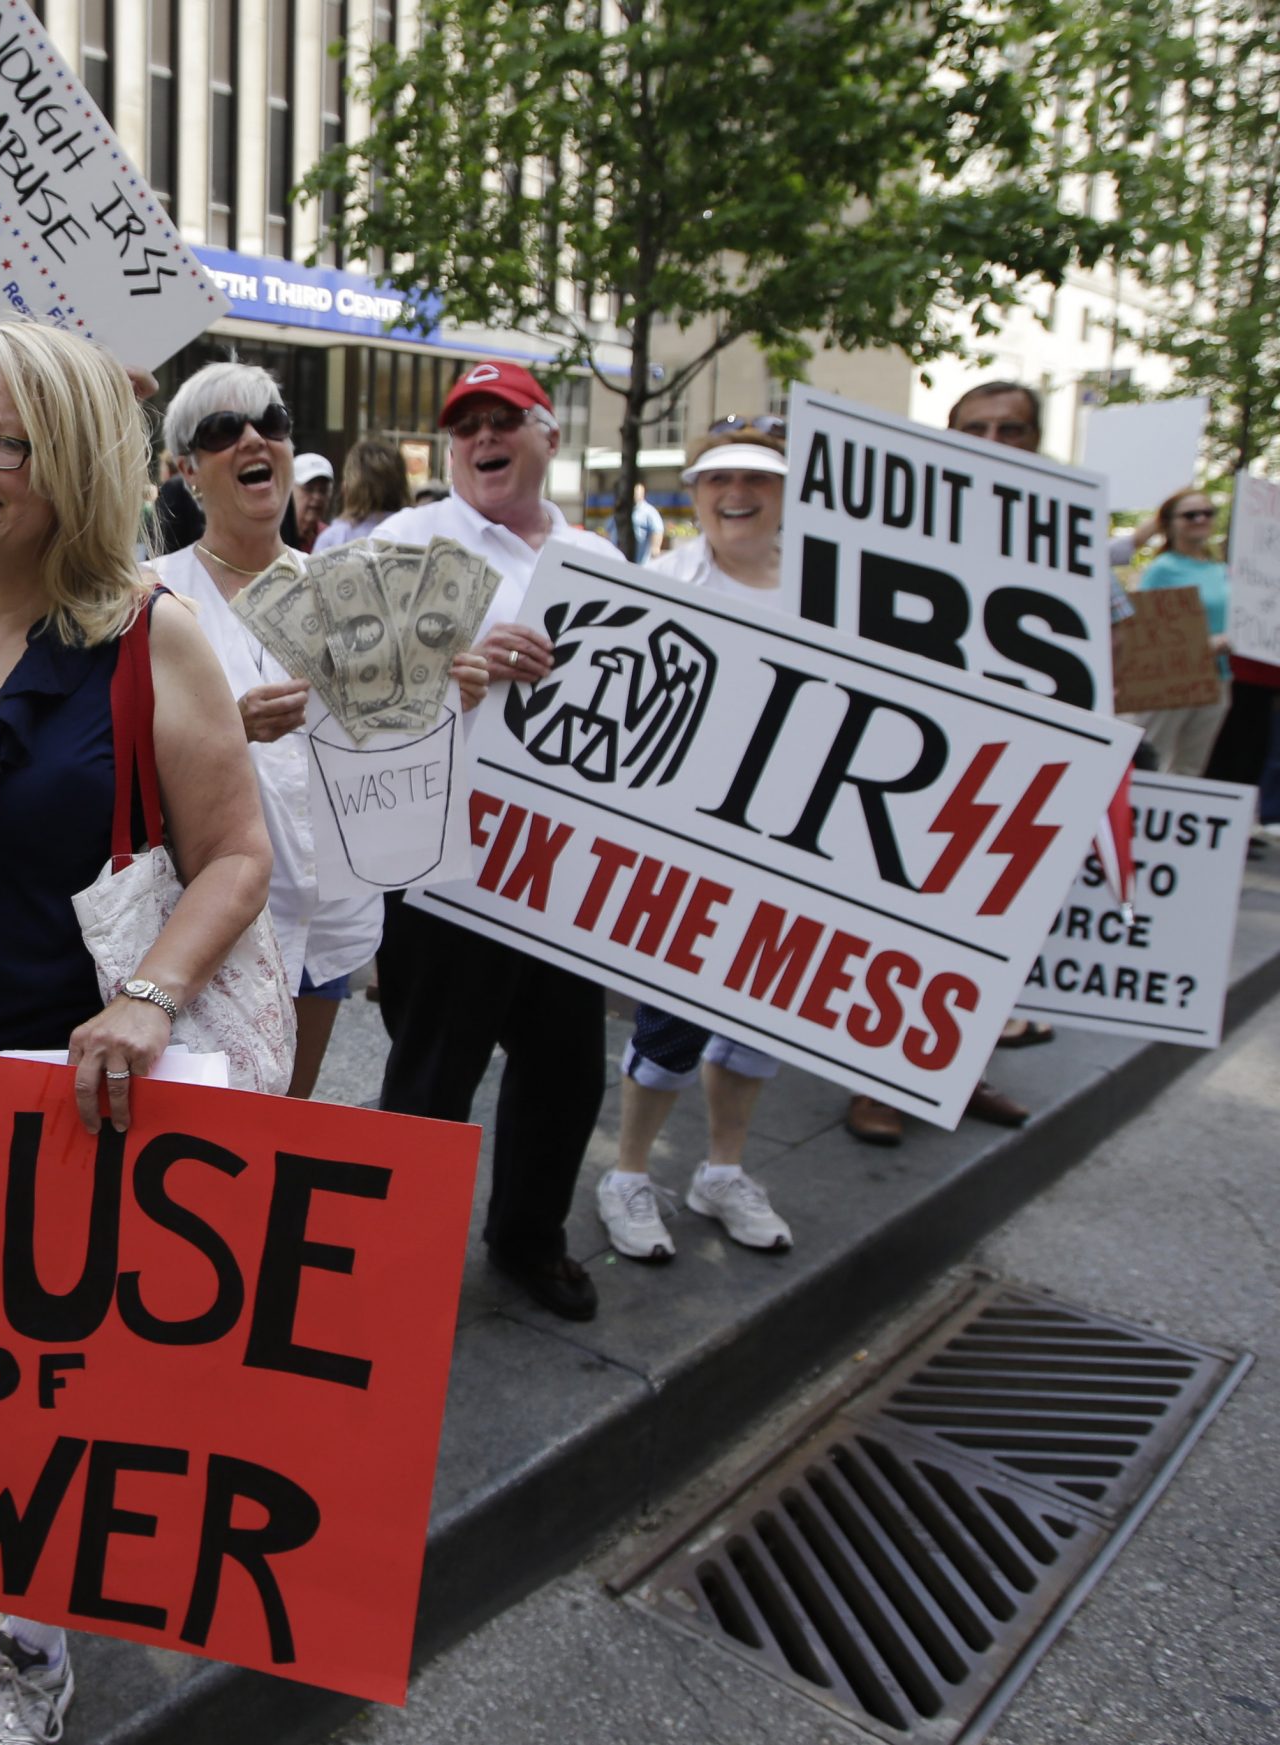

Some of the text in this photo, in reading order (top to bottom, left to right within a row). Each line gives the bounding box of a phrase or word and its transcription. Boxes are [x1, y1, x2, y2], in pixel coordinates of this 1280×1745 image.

[263, 275, 332, 313] THIRD
[799, 431, 1094, 577] AUDIT THE
[336, 761, 443, 816] WASTE
[1131, 806, 1230, 850] UST
[469, 789, 981, 1072] FIX THE MESS
[1024, 955, 1197, 1008] ACARE?
